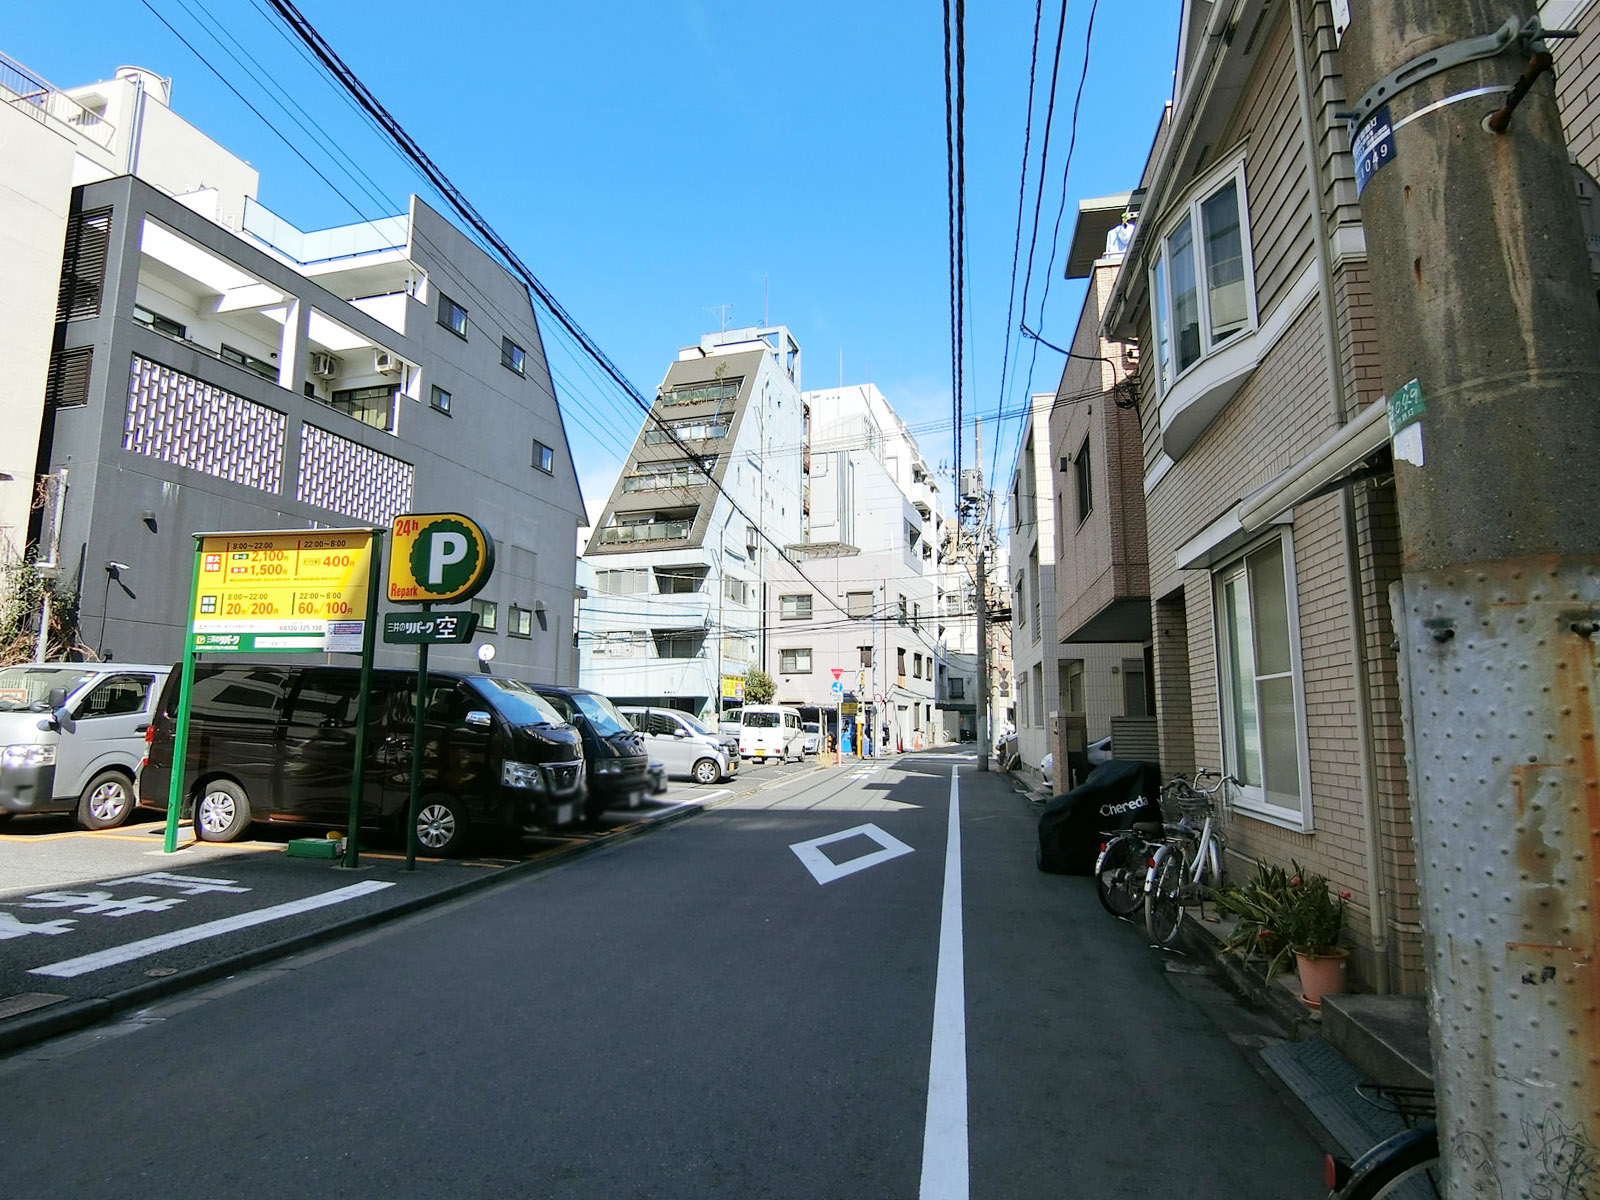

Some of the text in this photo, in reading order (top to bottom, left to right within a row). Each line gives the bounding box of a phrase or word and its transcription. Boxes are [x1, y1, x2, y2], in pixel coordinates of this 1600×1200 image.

[1360, 143, 1388, 179] 1049
[395, 519, 419, 537] 24h
[428, 532, 468, 585] P
[390, 583, 418, 599] Repark
[387, 615, 458, 639] 三井のリパーク 空
